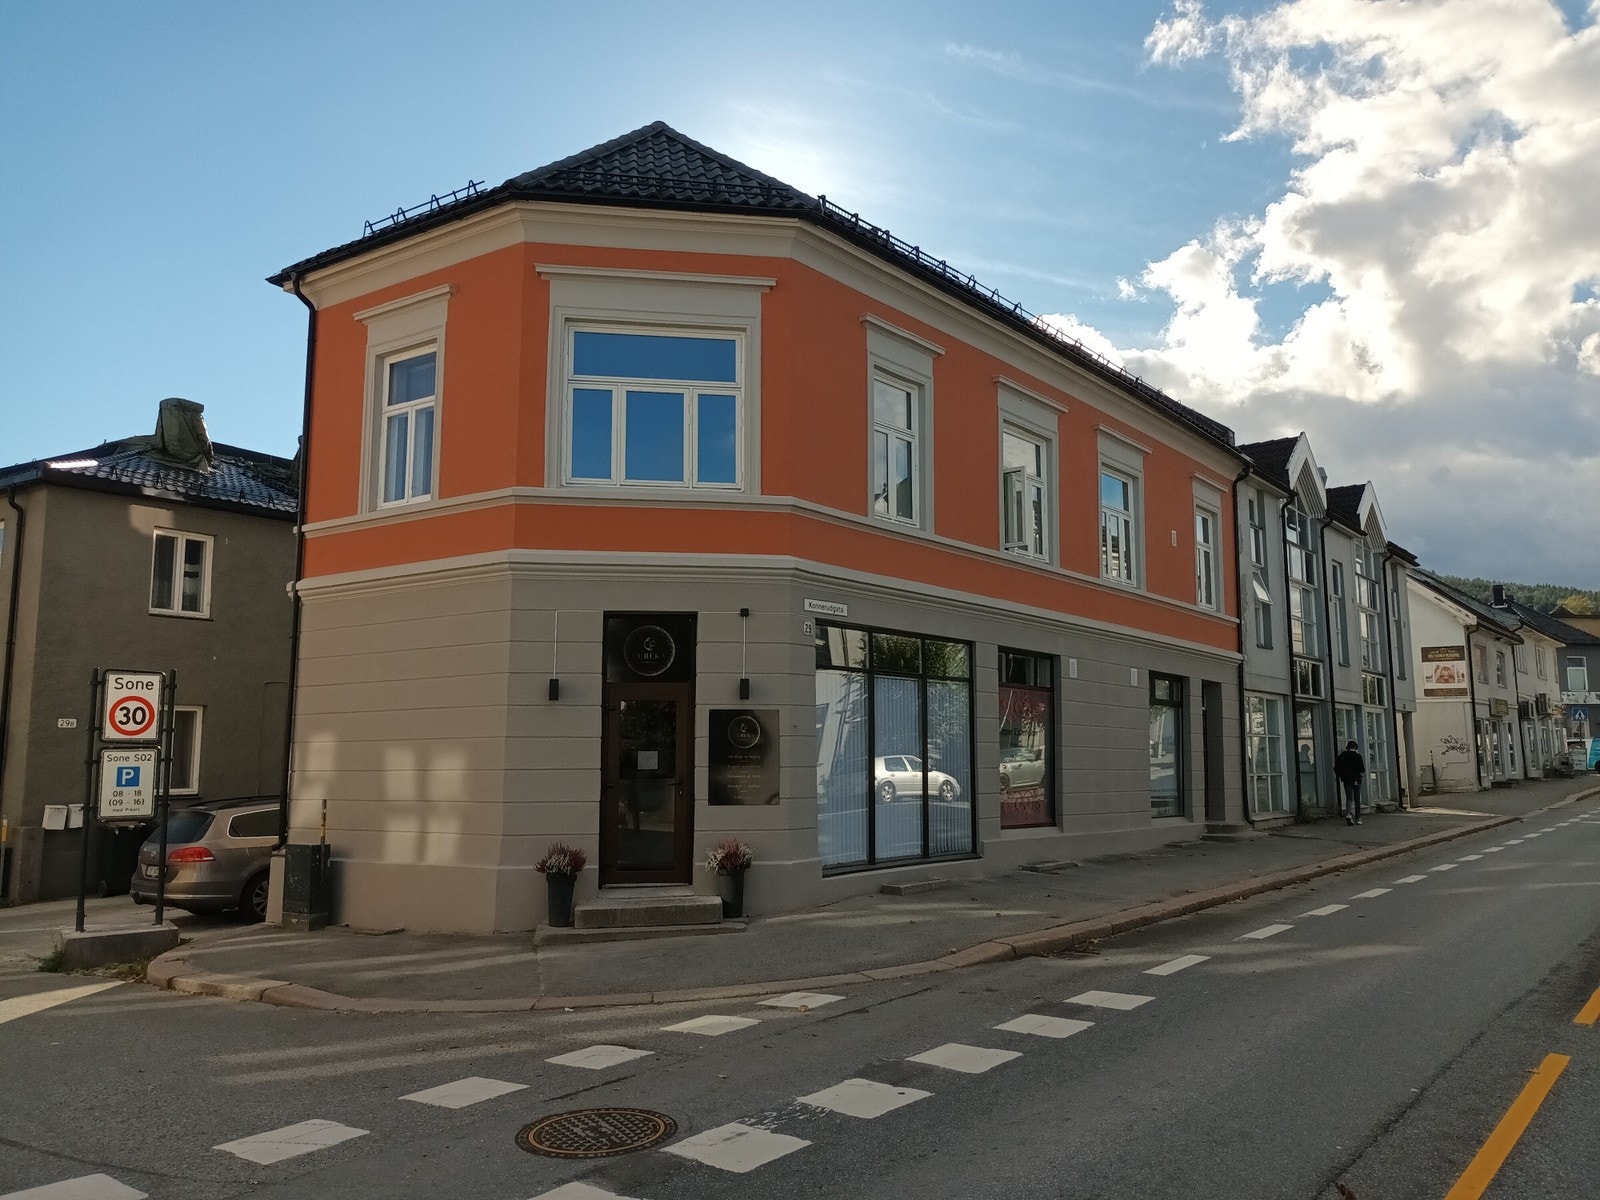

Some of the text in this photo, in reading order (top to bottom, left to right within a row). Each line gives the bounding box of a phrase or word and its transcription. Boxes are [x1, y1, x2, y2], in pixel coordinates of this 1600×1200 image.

[808, 602, 844, 614] Konnerudgata
[114, 677, 154, 691] Sone
[118, 706, 147, 726] 30
[106, 753, 153, 763] Sone S02
[122, 769, 135, 785] P
[134, 789, 142, 797] 18
[108, 797, 124, 806] (09
[133, 796, 145, 806] 16)
